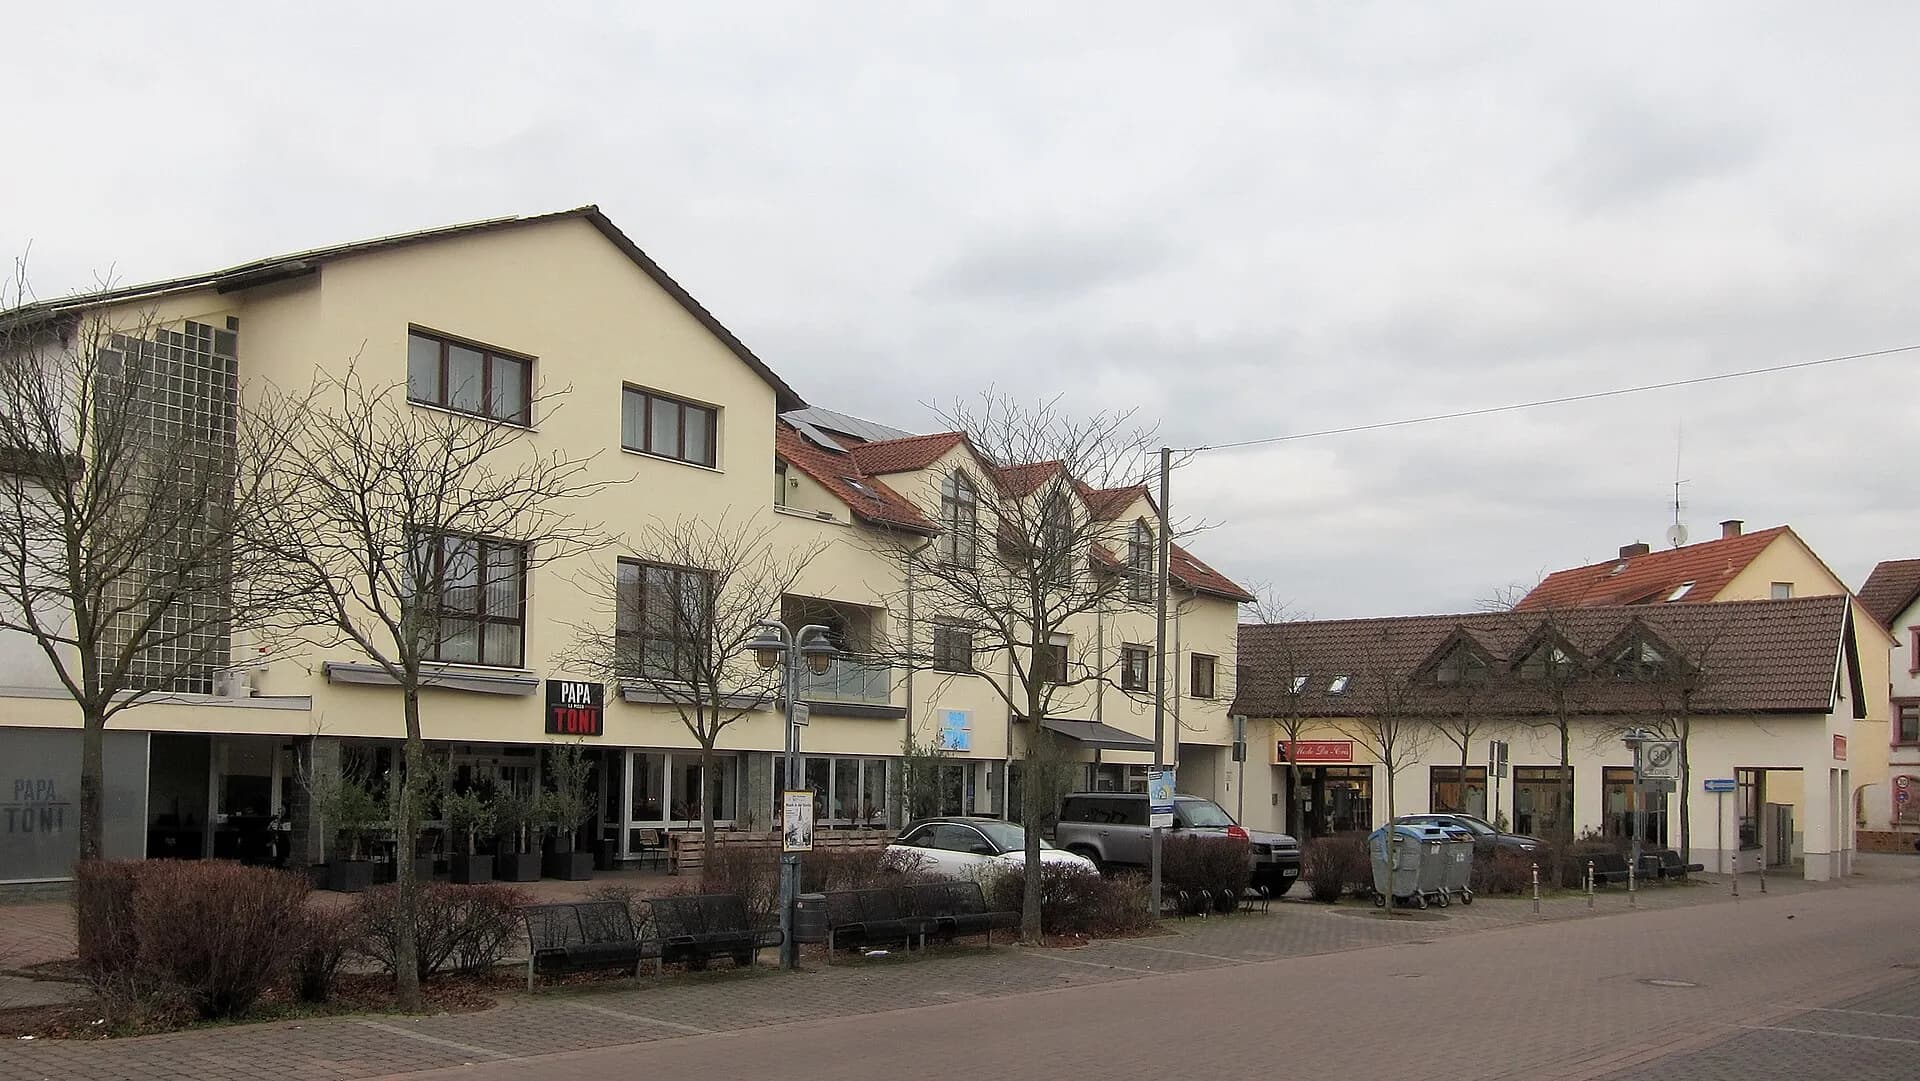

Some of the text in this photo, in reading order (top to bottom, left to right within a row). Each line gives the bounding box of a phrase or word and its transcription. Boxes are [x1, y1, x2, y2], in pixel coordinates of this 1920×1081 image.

[561, 682, 591, 704] PAPA
[554, 707, 597, 734] TONI
[1653, 750, 1667, 761] 30
[15, 779, 56, 800] PAPA
[4, 807, 64, 832] TONI
